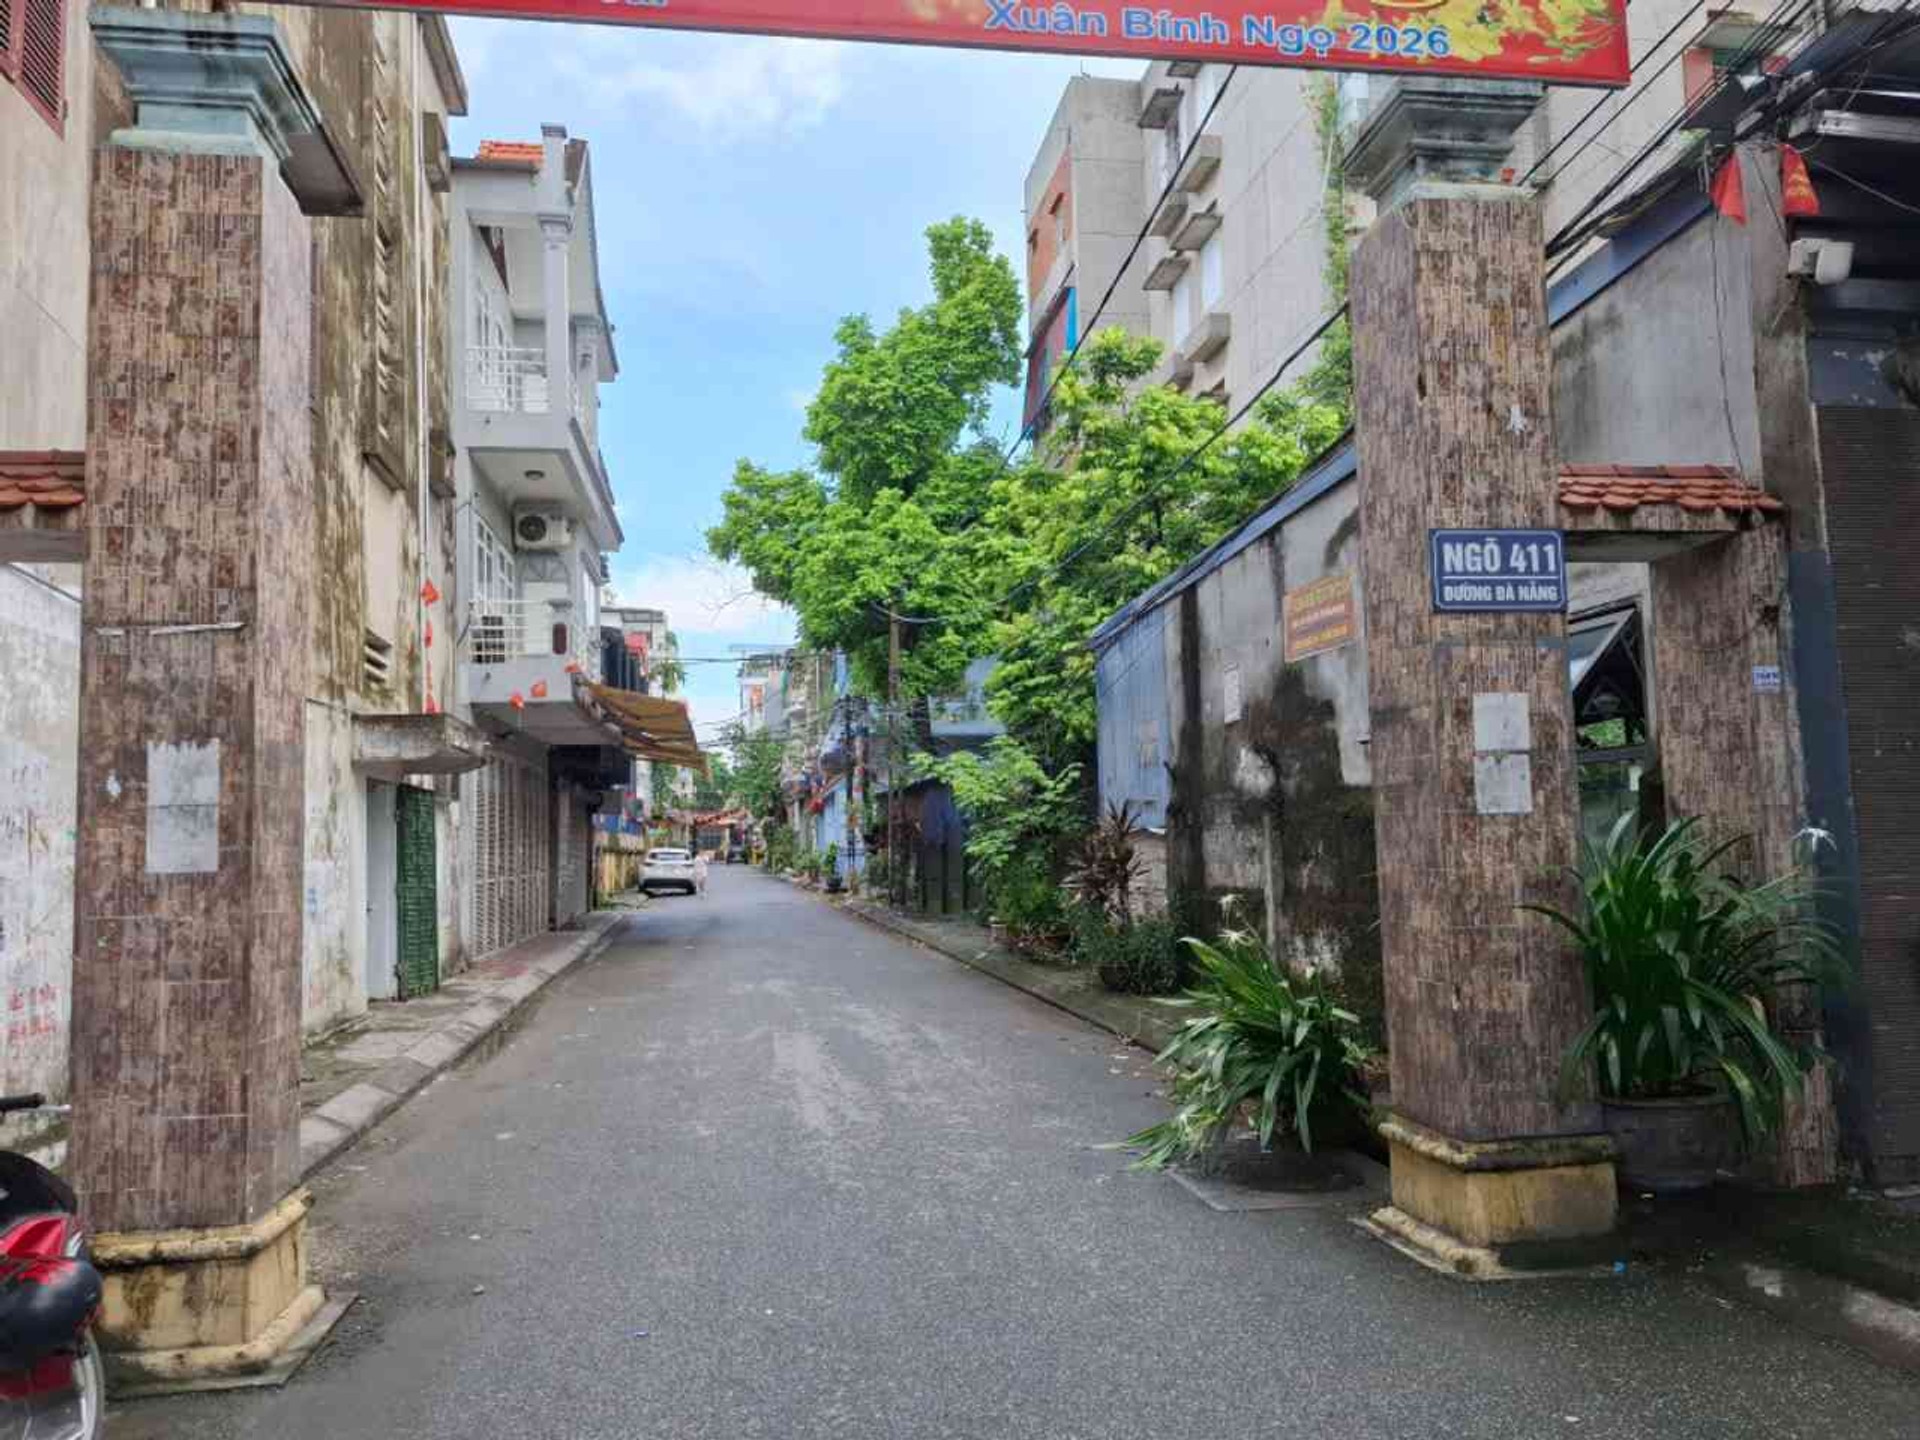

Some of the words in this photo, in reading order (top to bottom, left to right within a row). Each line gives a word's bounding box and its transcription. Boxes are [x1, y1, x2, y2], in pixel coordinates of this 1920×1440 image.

[984, 0, 1107, 36] Xuân
[1121, 7, 1230, 44] Bính
[1242, 14, 1335, 59] Ngọ
[1349, 22, 1450, 57] 2026
[1442, 537, 1501, 573] NGÕ
[1509, 543, 1557, 573] 411
[1495, 581, 1515, 601] ĐÀ
